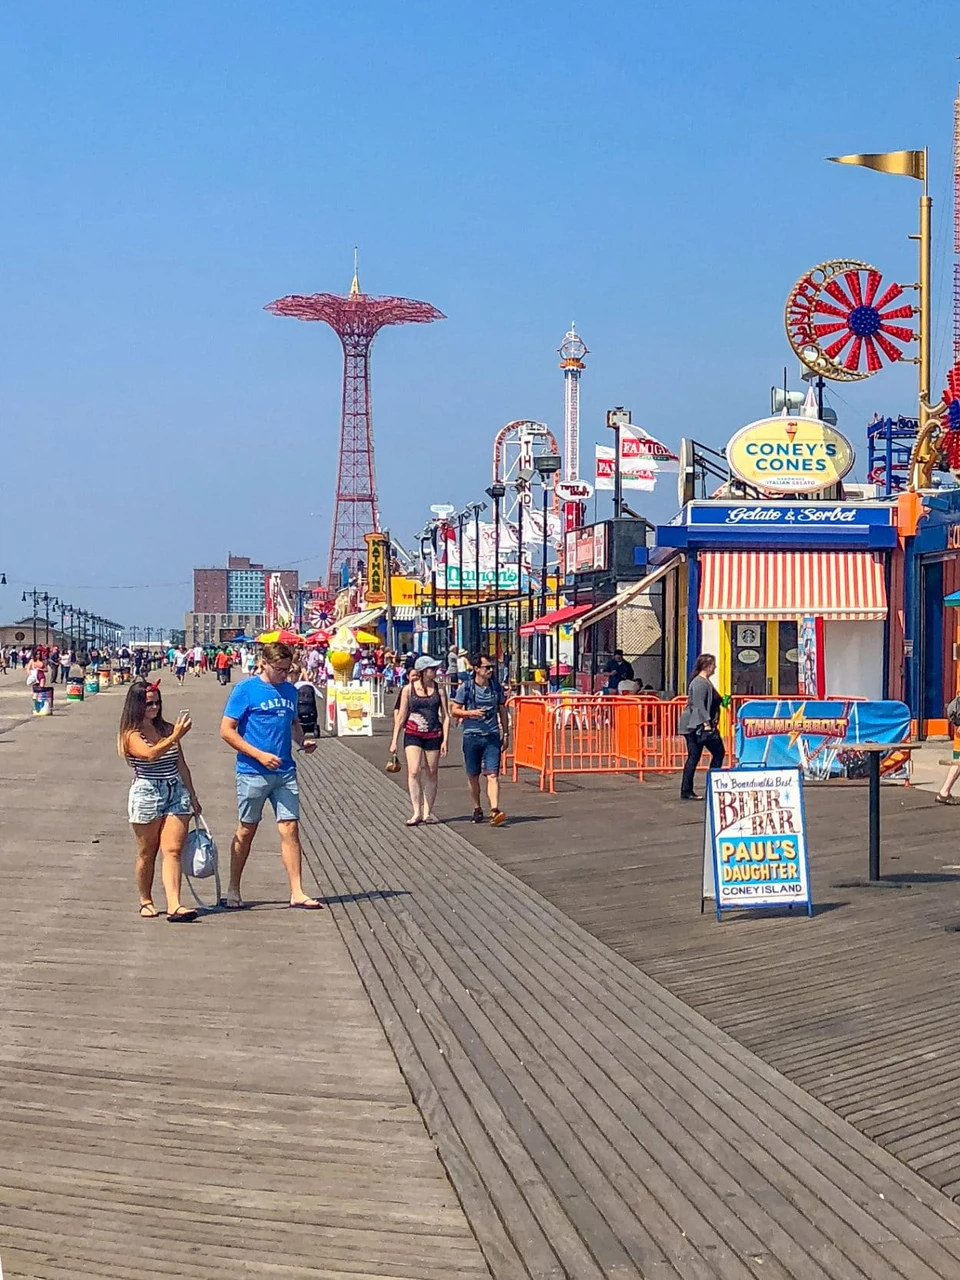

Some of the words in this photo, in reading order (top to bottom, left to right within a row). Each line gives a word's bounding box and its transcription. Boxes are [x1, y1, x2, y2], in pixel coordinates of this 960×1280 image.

[745, 443, 837, 456] CONEY'S
[756, 458, 826, 471] CONES
[726, 507, 782, 524] Gelato
[785, 510, 795, 521] &
[798, 507, 857, 521] Sorbet
[371, 539, 381, 593] NATHANS
[744, 719, 848, 736] THUNDERBOLT
[714, 779, 728, 789] The
[776, 777, 793, 787] Best
[714, 789, 781, 832] BEER
[750, 810, 801, 835] BAR
[721, 840, 797, 863] PAUL'S
[723, 863, 798, 882] DAUGHTER
[722, 885, 760, 896] CONEY
[762, 884, 802, 895] ISLAND
